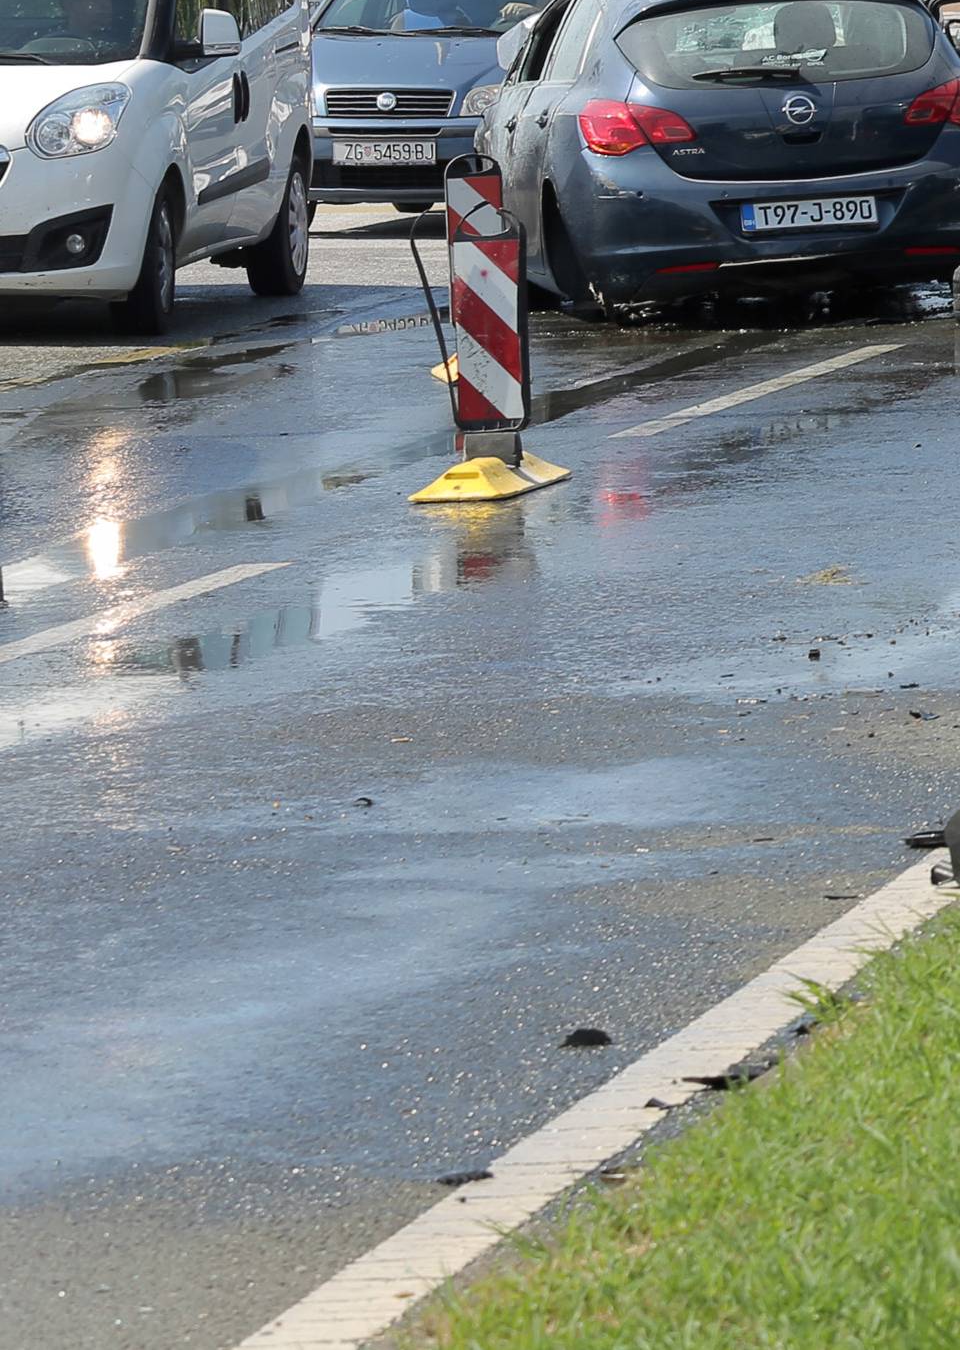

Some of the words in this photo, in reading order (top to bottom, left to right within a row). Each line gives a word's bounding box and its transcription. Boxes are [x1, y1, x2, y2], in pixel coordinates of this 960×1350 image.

[344, 143, 363, 161] ZG
[672, 147, 706, 156] ASTRA
[757, 198, 873, 227] T97-J-890
